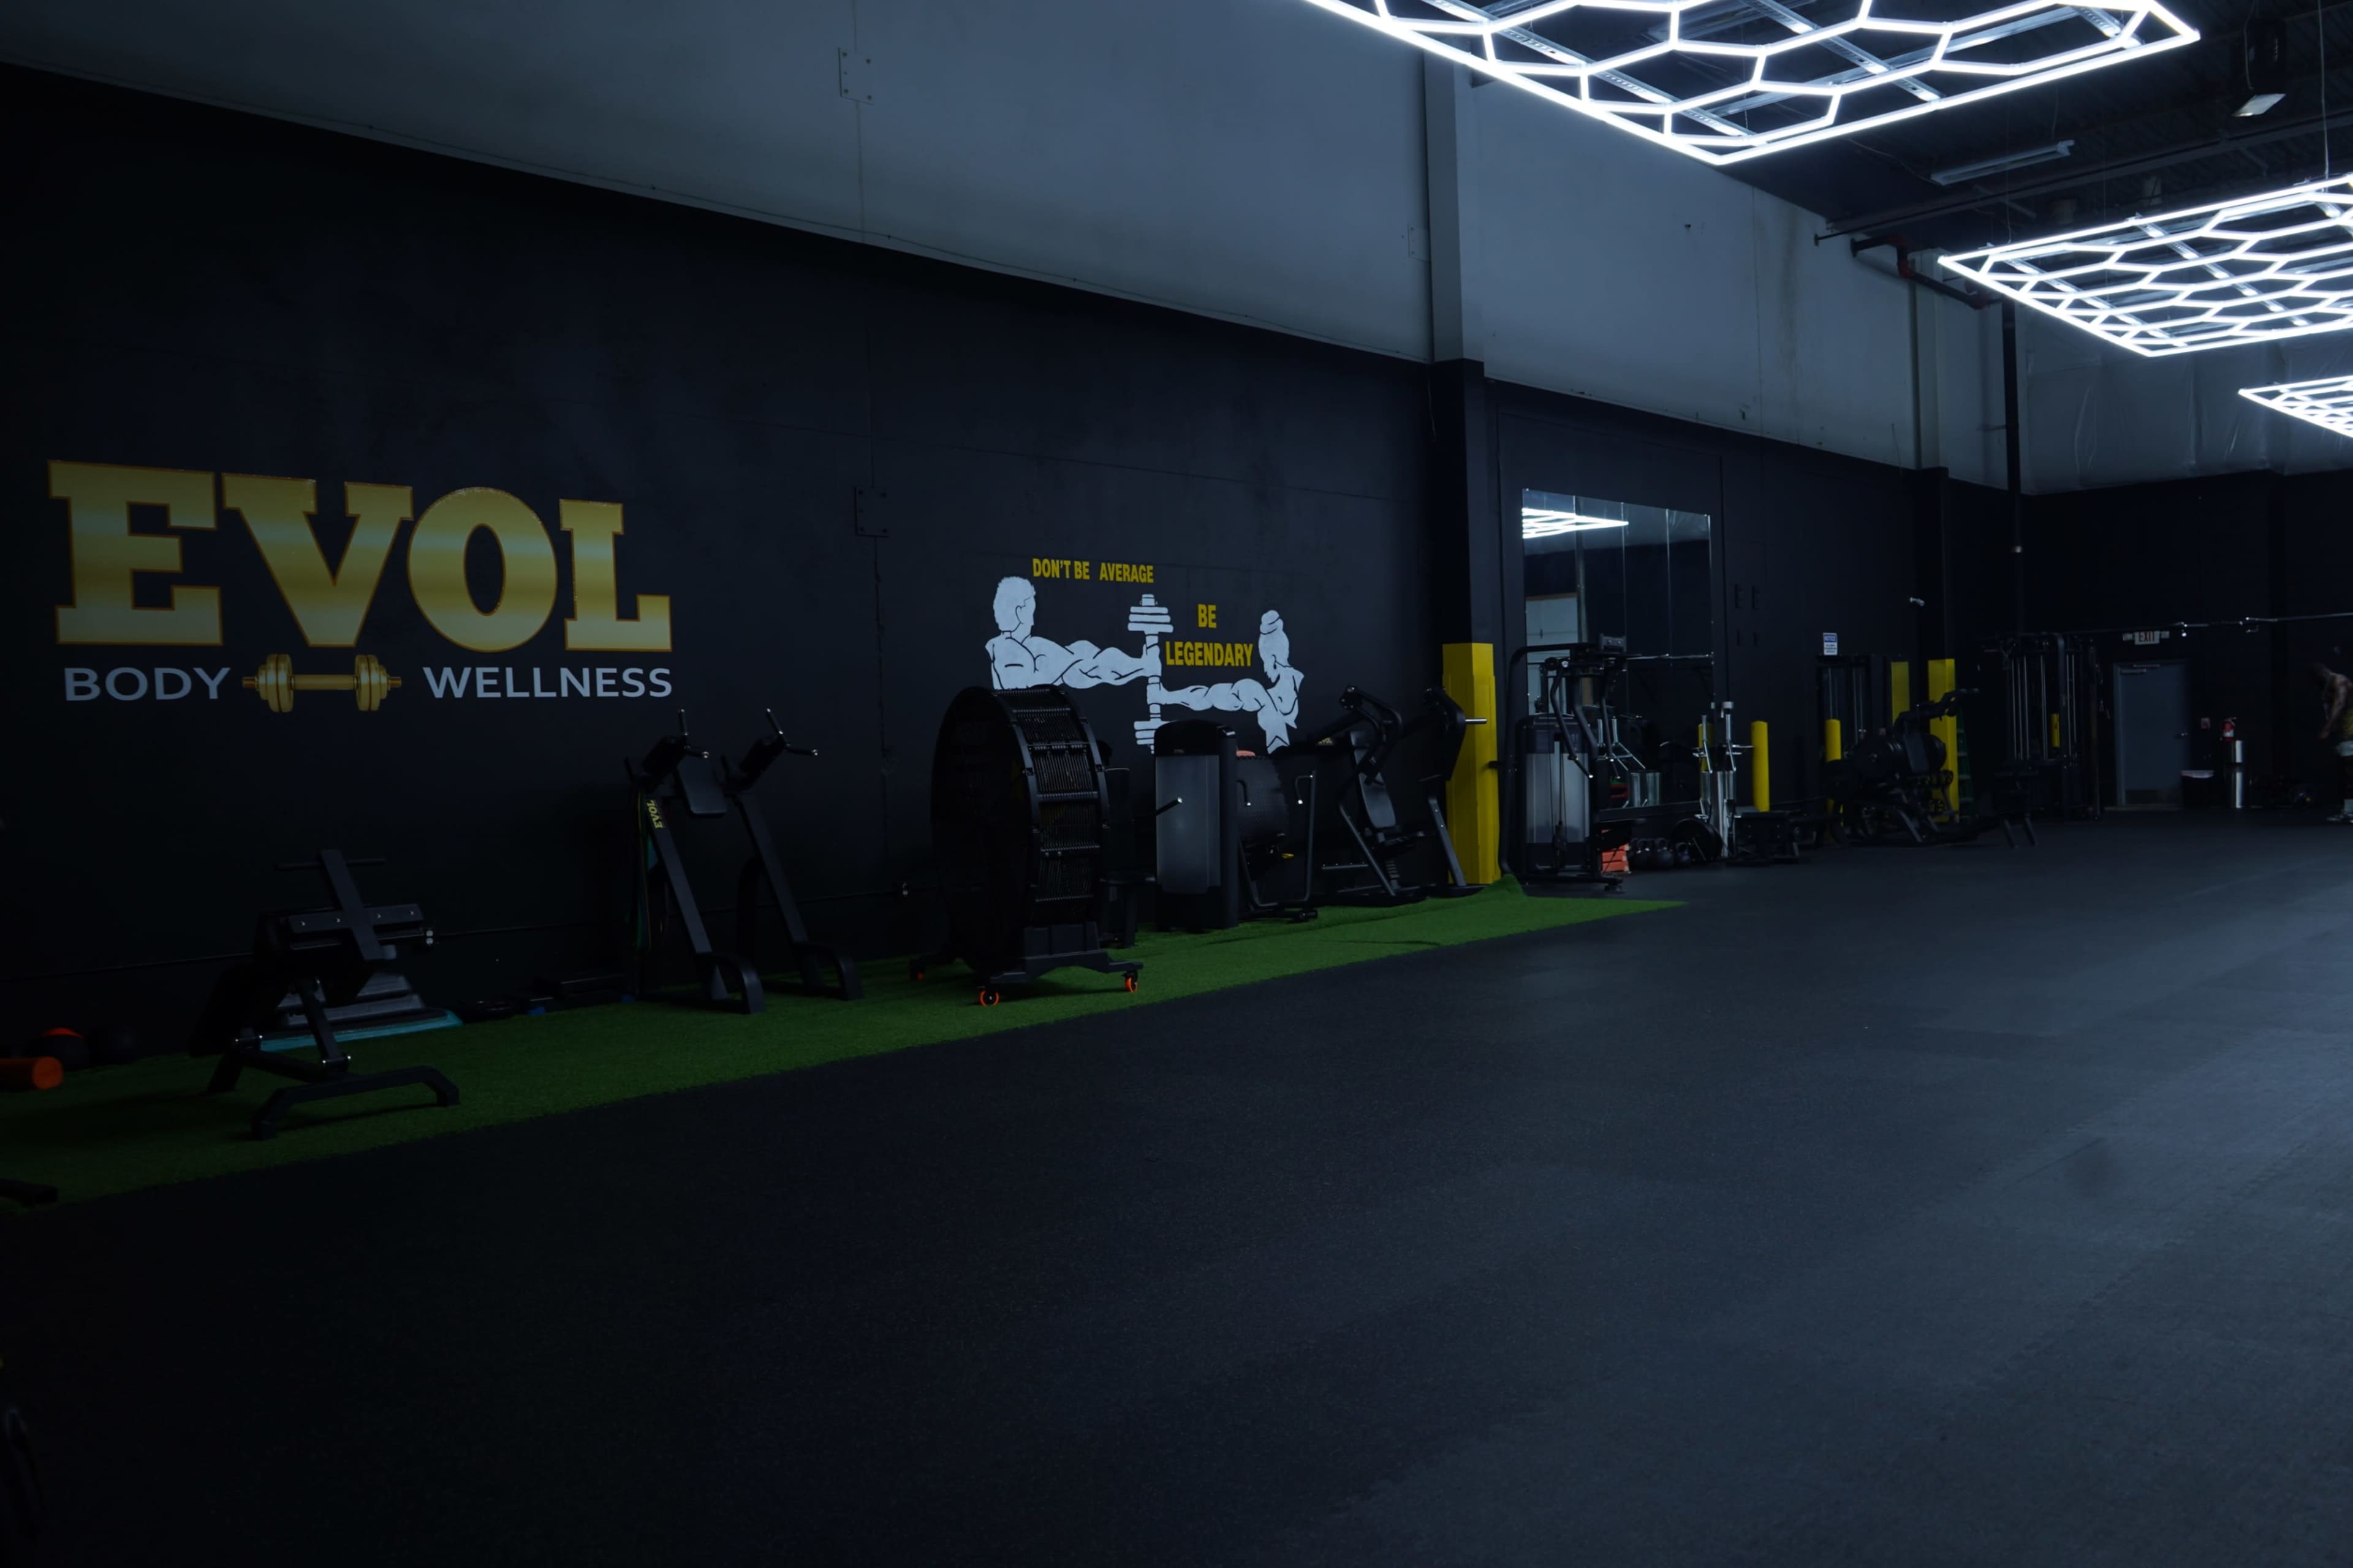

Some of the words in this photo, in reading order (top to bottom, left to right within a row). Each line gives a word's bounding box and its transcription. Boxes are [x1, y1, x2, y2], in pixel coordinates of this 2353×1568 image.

[48, 460, 673, 653] EVOL
[1032, 558, 1071, 578] DON'T
[1074, 561, 1090, 580] BE
[1099, 562, 1154, 583] AVERAGE
[1197, 604, 1217, 629] BE
[2139, 631, 2156, 642] EXIT
[1165, 641, 1254, 667] LEGENDARY
[64, 667, 230, 701] BODY
[423, 667, 672, 698] WELLNESS
